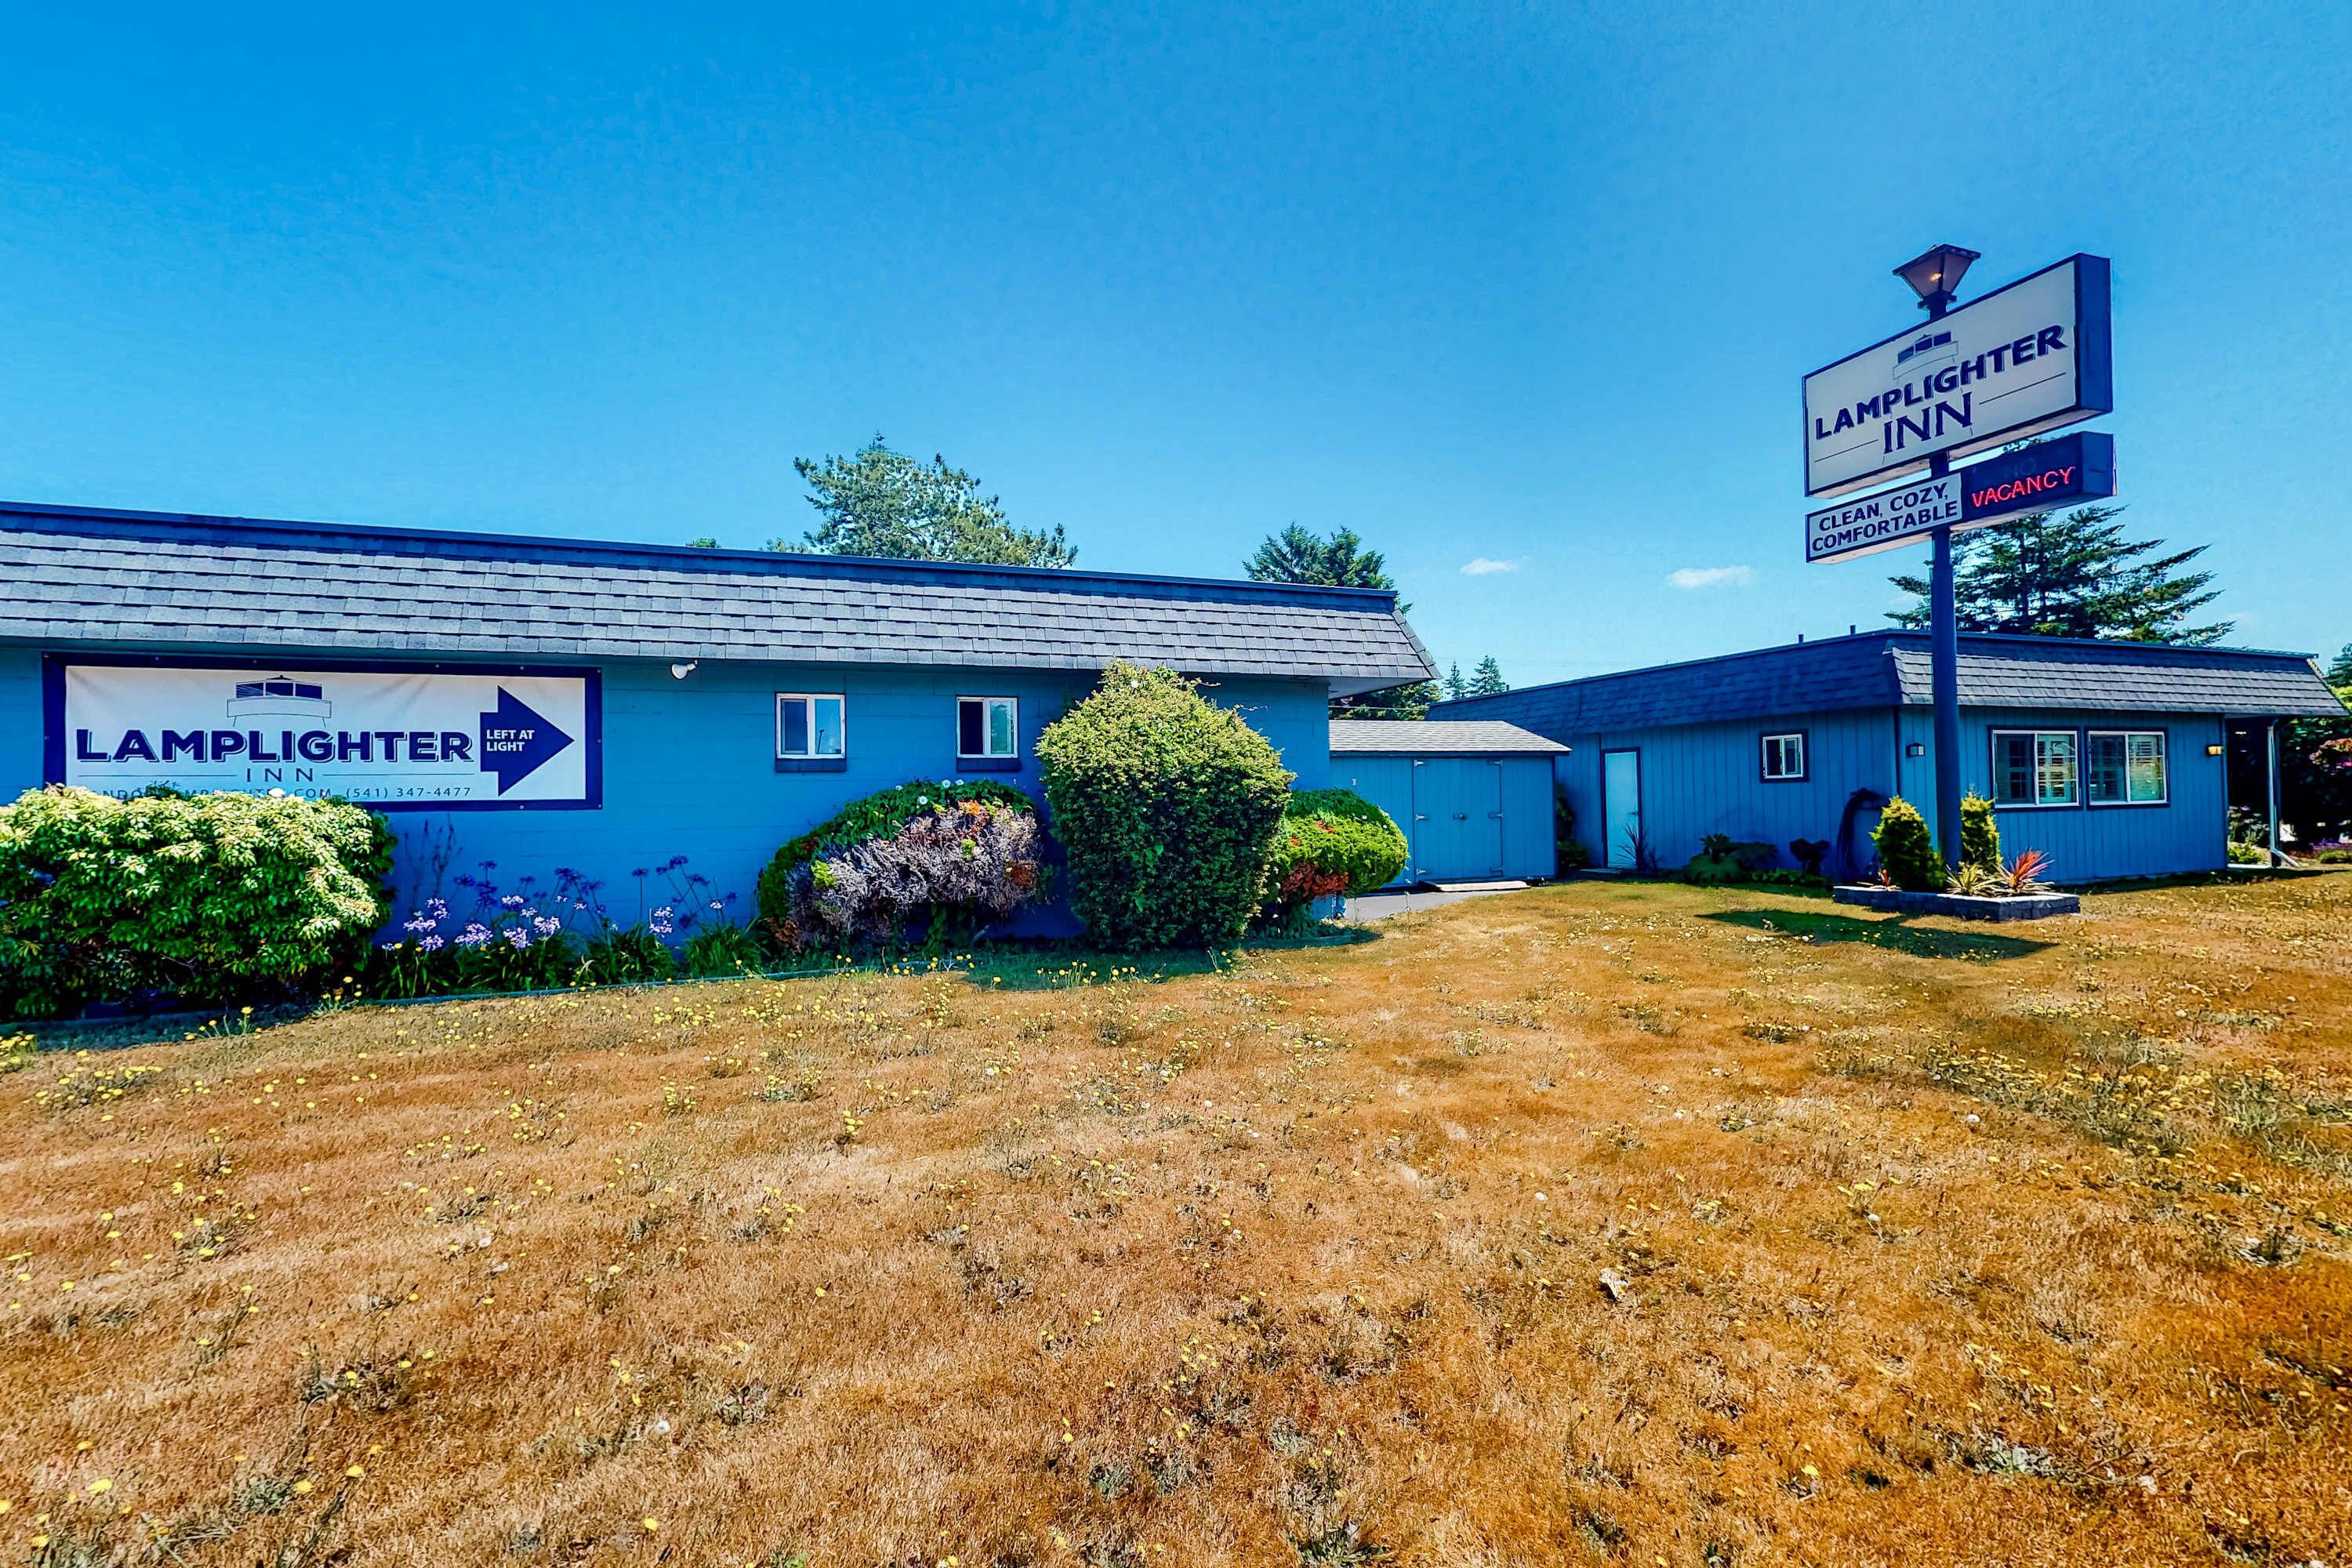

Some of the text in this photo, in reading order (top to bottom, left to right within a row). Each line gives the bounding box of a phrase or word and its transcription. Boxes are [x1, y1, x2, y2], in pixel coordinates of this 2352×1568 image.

[1815, 324, 2069, 441] LAMPLIGHTER
[1882, 391, 1973, 455] INN
[1971, 466, 2076, 507] VACANCY
[1812, 500, 1958, 551] COMFORTABLE
[1818, 481, 1948, 532] CLEAN, COZY,
[76, 728, 475, 763] LAMPLIGHTER
[486, 729, 535, 739] LEFT AT
[486, 741, 525, 751] LIGHT
[246, 767, 313, 782] INN
[346, 787, 388, 799] (541)
[396, 786, 471, 797] 347-4477
